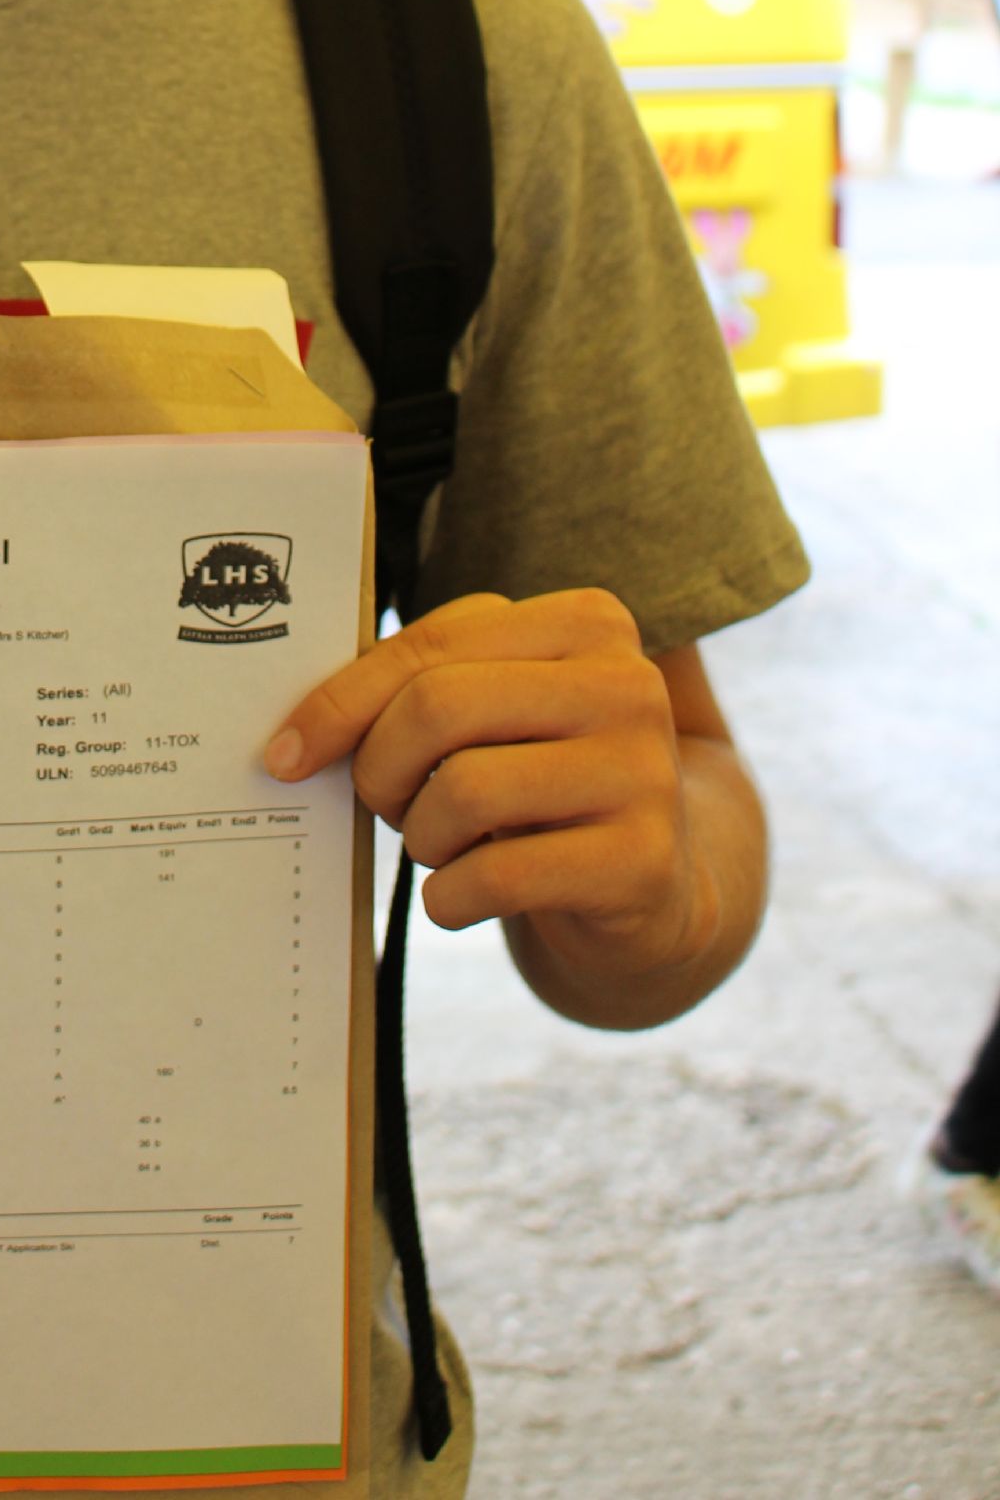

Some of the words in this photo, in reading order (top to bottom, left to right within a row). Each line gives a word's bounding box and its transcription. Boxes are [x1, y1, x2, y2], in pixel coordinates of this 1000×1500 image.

[202, 565, 269, 586] LHS
[16, 631, 24, 641] S
[27, 630, 69, 641] Kitcher)
[37, 687, 88, 700] Series:
[103, 683, 131, 699] (All)
[37, 715, 75, 727] Year:
[92, 712, 106, 724] 11
[36, 743, 69, 757] Reg.
[75, 741, 126, 754] Group:
[146, 734, 200, 748] 11-TOX
[36, 768, 72, 780] ULN:
[90, 761, 177, 778] 5099467643
[268, 815, 300, 823] Points
